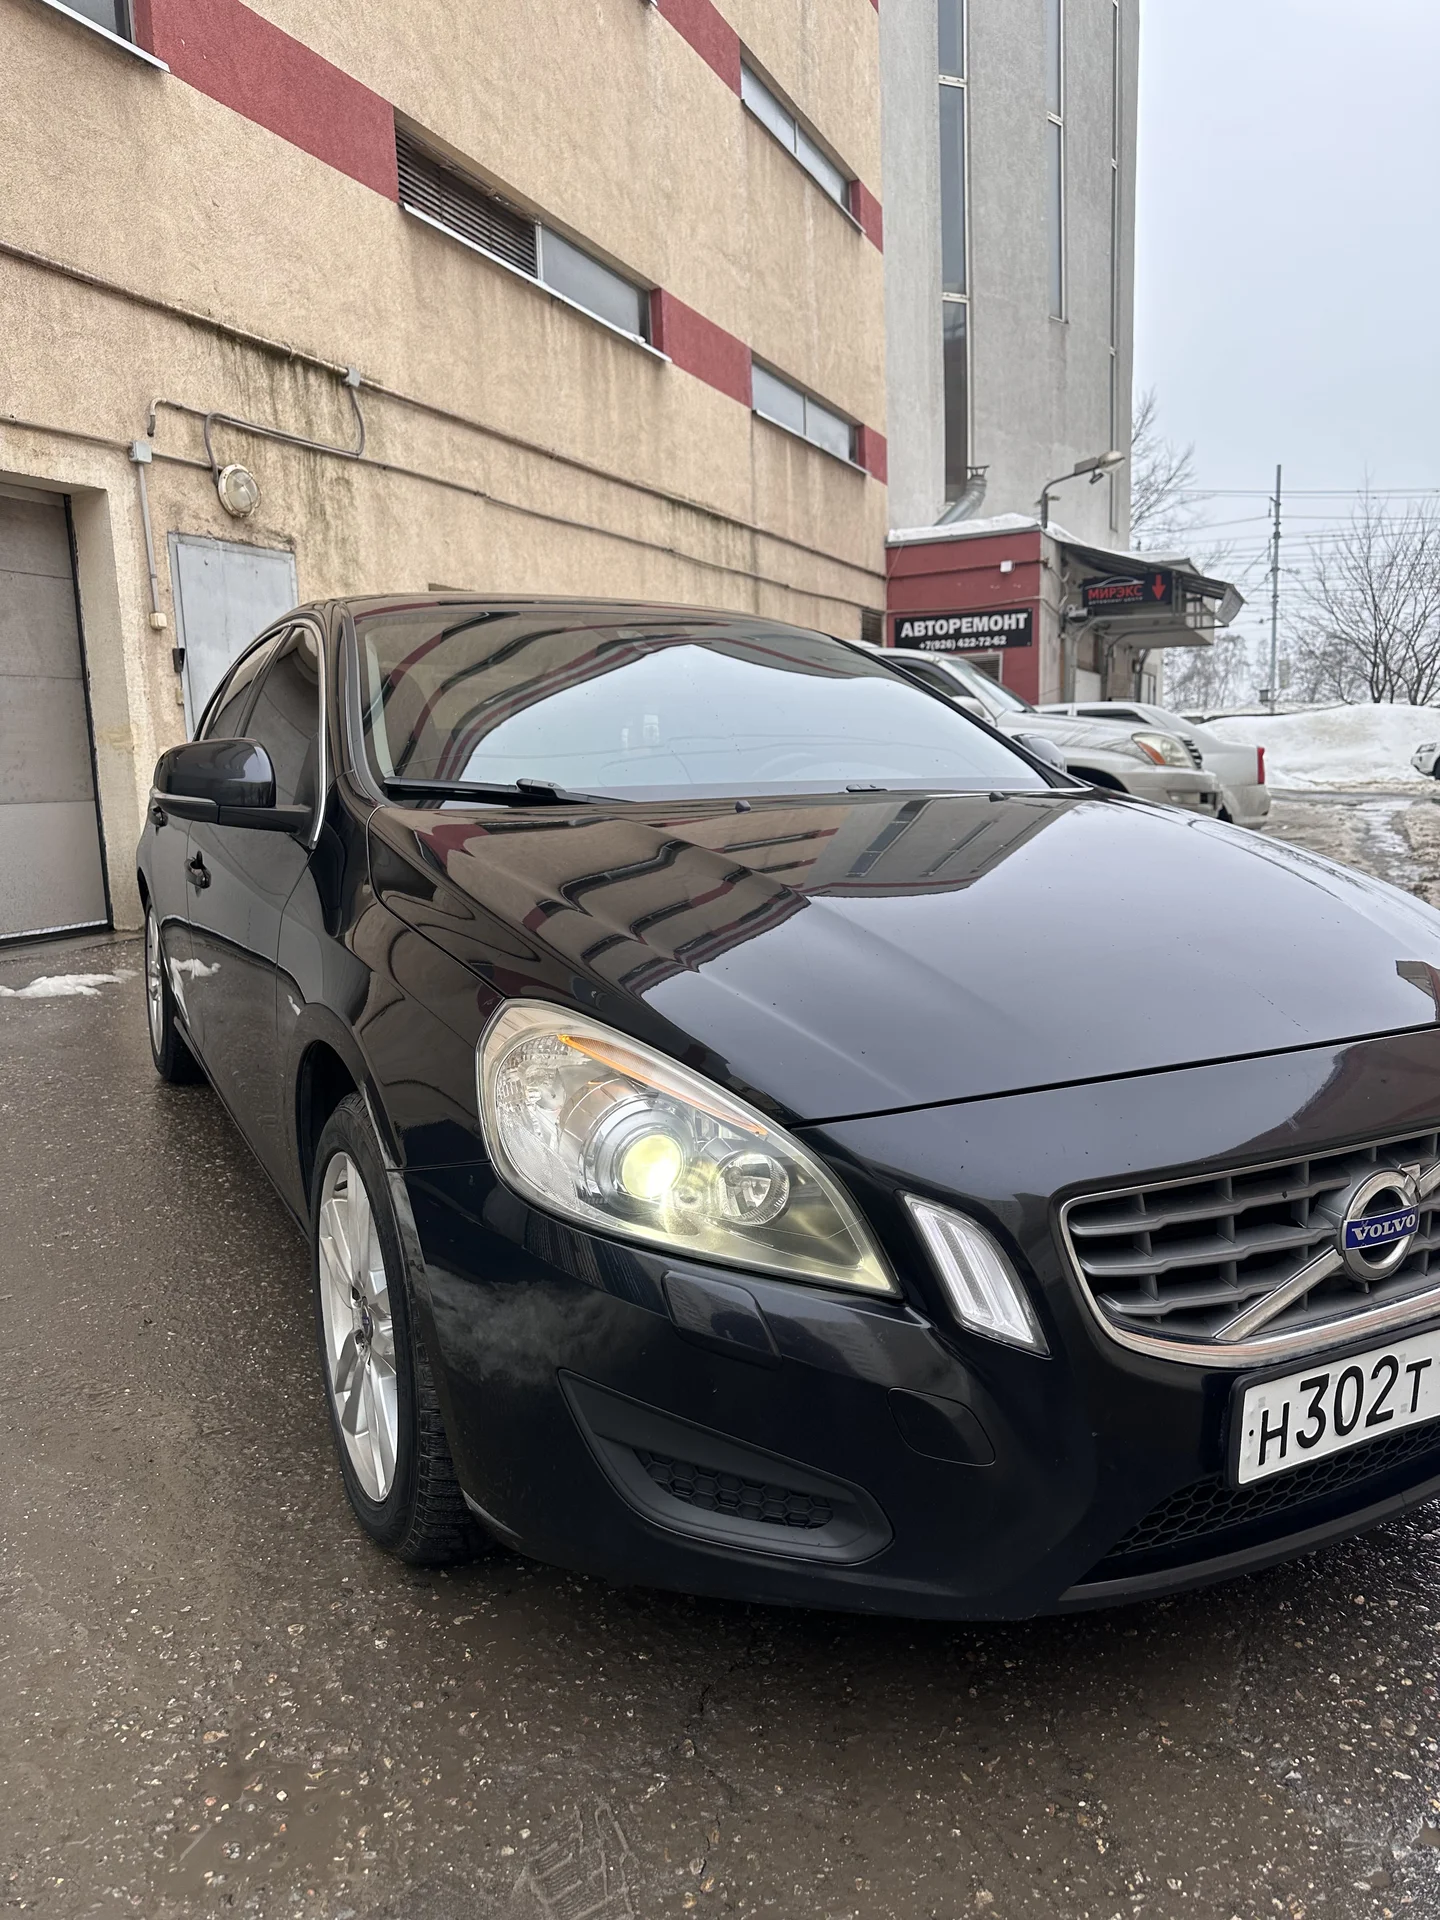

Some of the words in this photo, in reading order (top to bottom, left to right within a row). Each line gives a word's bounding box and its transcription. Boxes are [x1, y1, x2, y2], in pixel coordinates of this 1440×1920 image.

[1087, 584, 1143, 600] МИРЭКС
[900, 613, 1028, 638] АВТОРЕМОНТ
[1352, 1214, 1416, 1241] VOLVO
